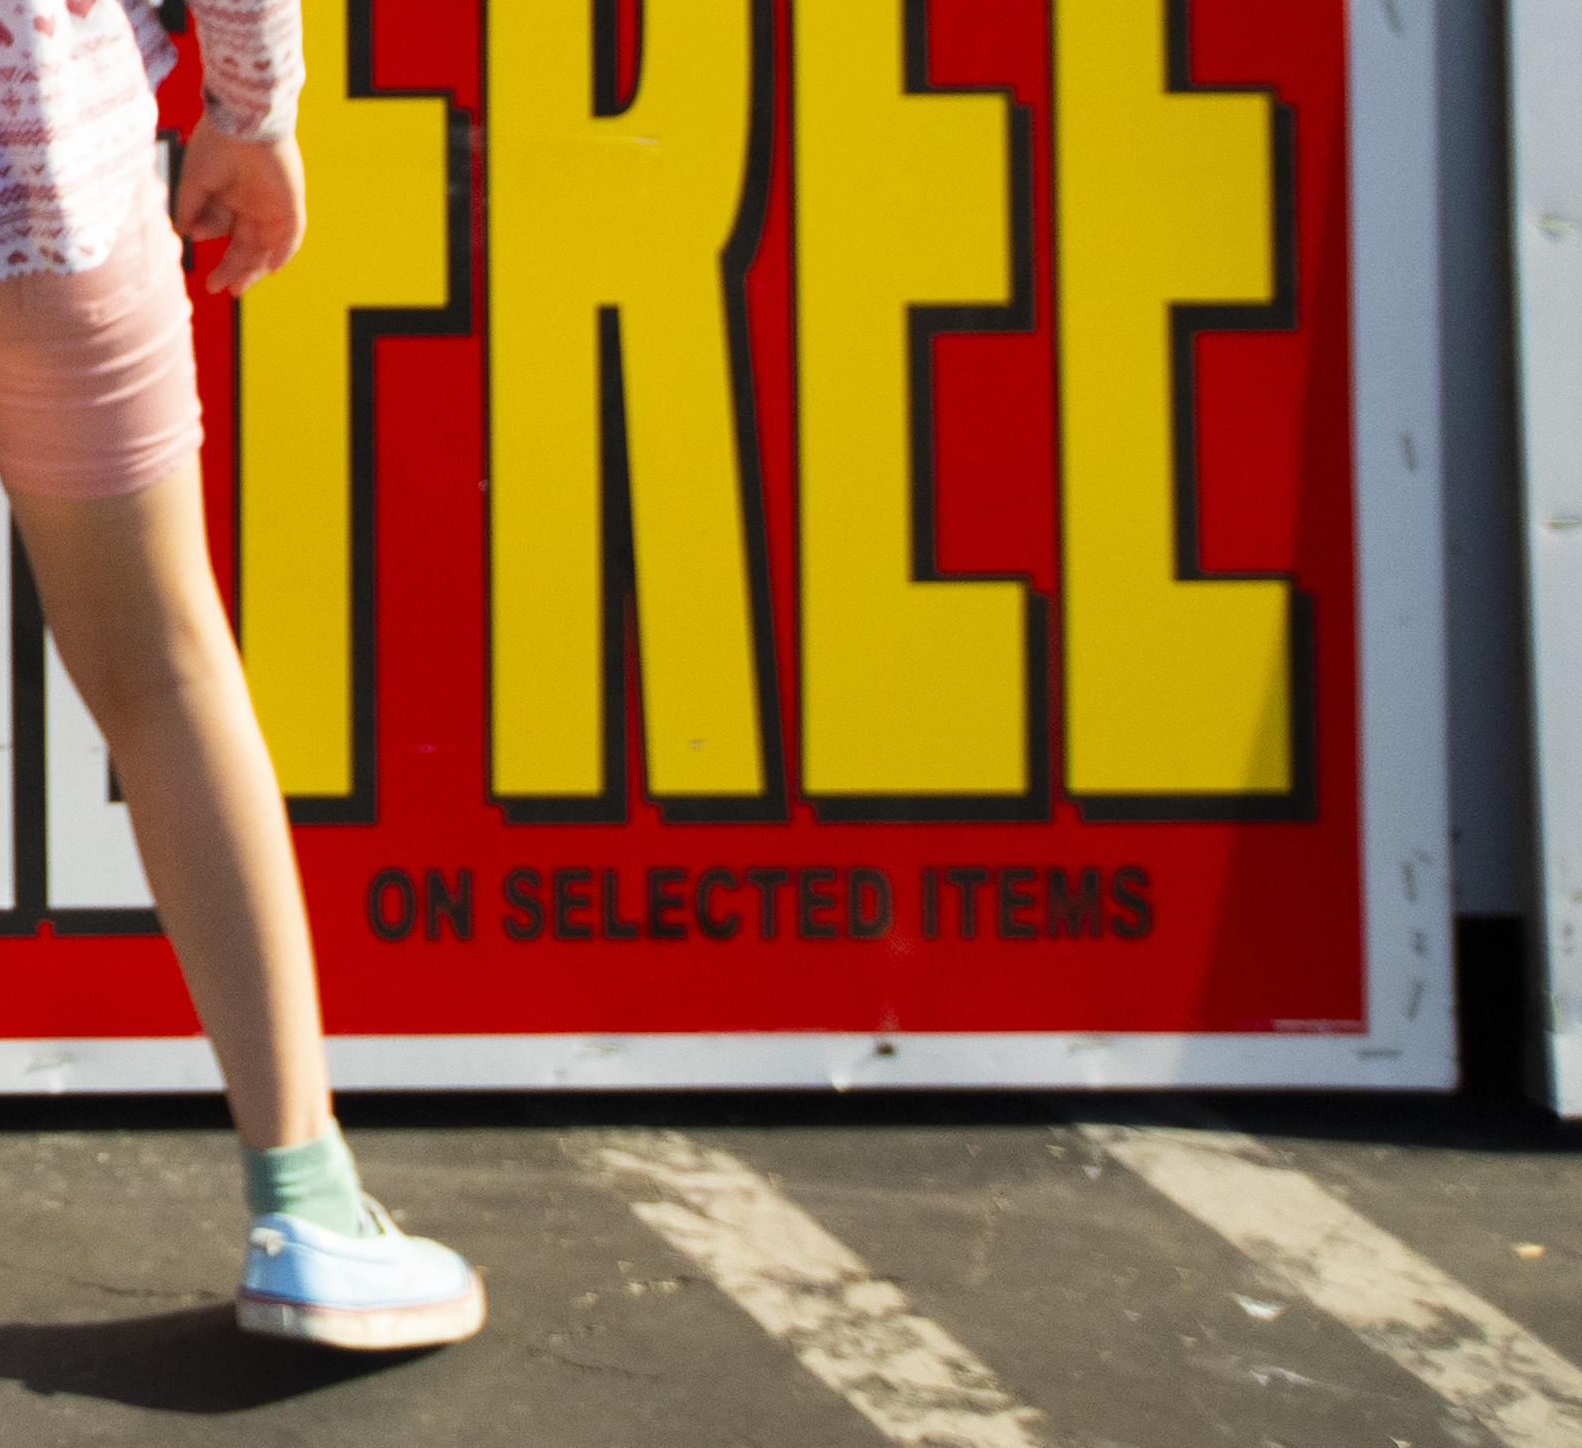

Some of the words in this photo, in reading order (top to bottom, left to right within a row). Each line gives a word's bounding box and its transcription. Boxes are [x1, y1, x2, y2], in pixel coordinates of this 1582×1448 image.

[367, 864, 474, 945] ON
[496, 862, 891, 944] SELECTED
[917, 861, 1153, 941] ITEMS
